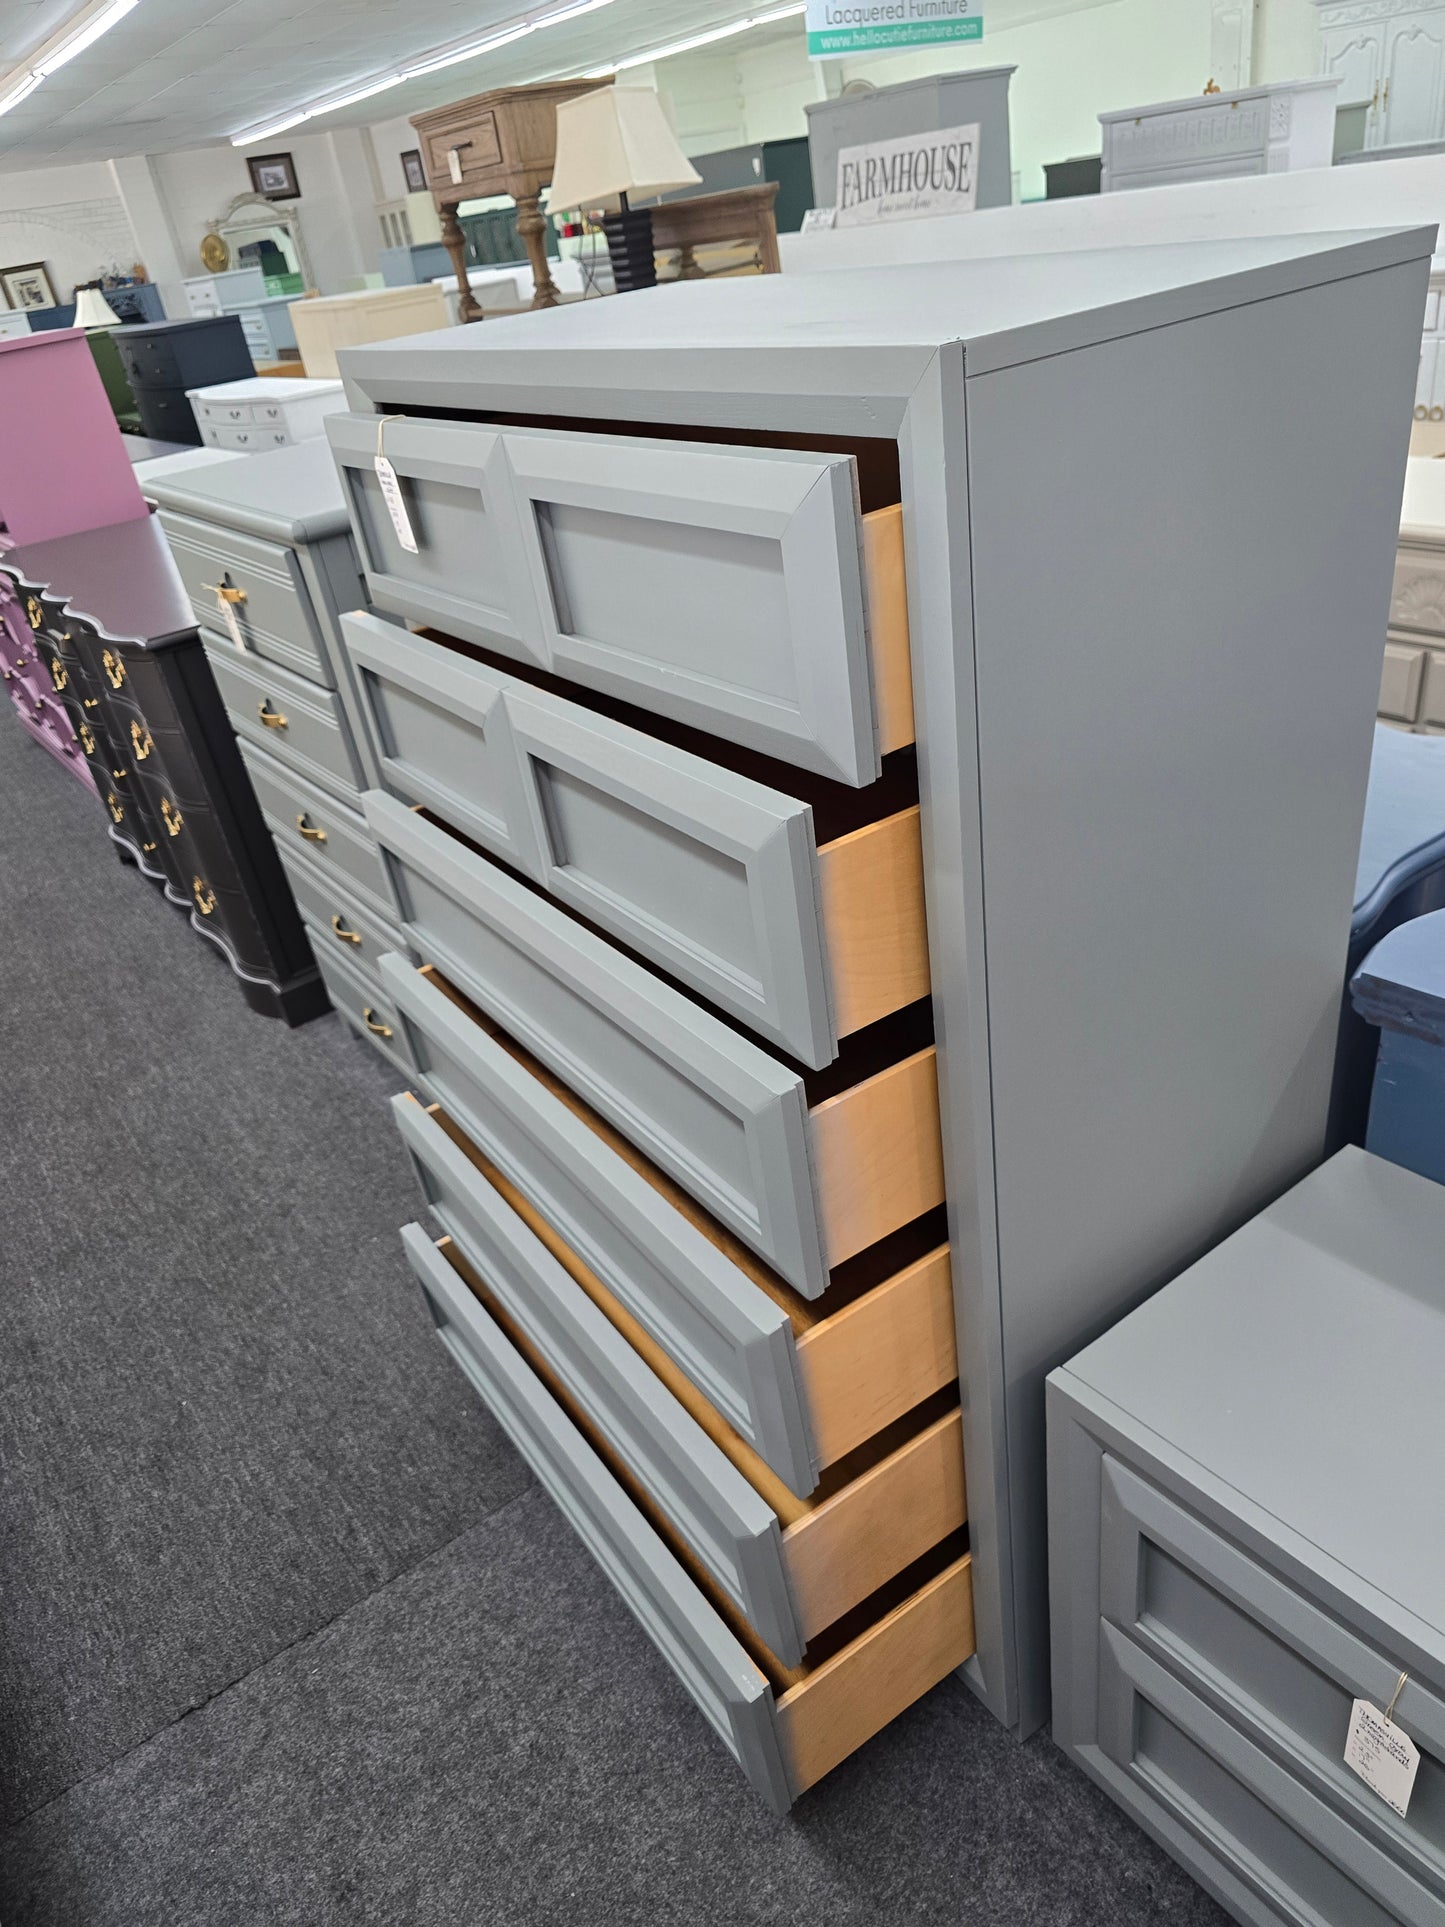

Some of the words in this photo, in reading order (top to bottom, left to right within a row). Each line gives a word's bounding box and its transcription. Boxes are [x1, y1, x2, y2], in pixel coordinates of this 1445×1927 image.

[825, 4, 905, 29] Lacquered
[909, 0, 968, 18] Furniture
[820, 22, 978, 50] www.hellocutiefurniture.com
[841, 142, 972, 211] FARMHOUSE
